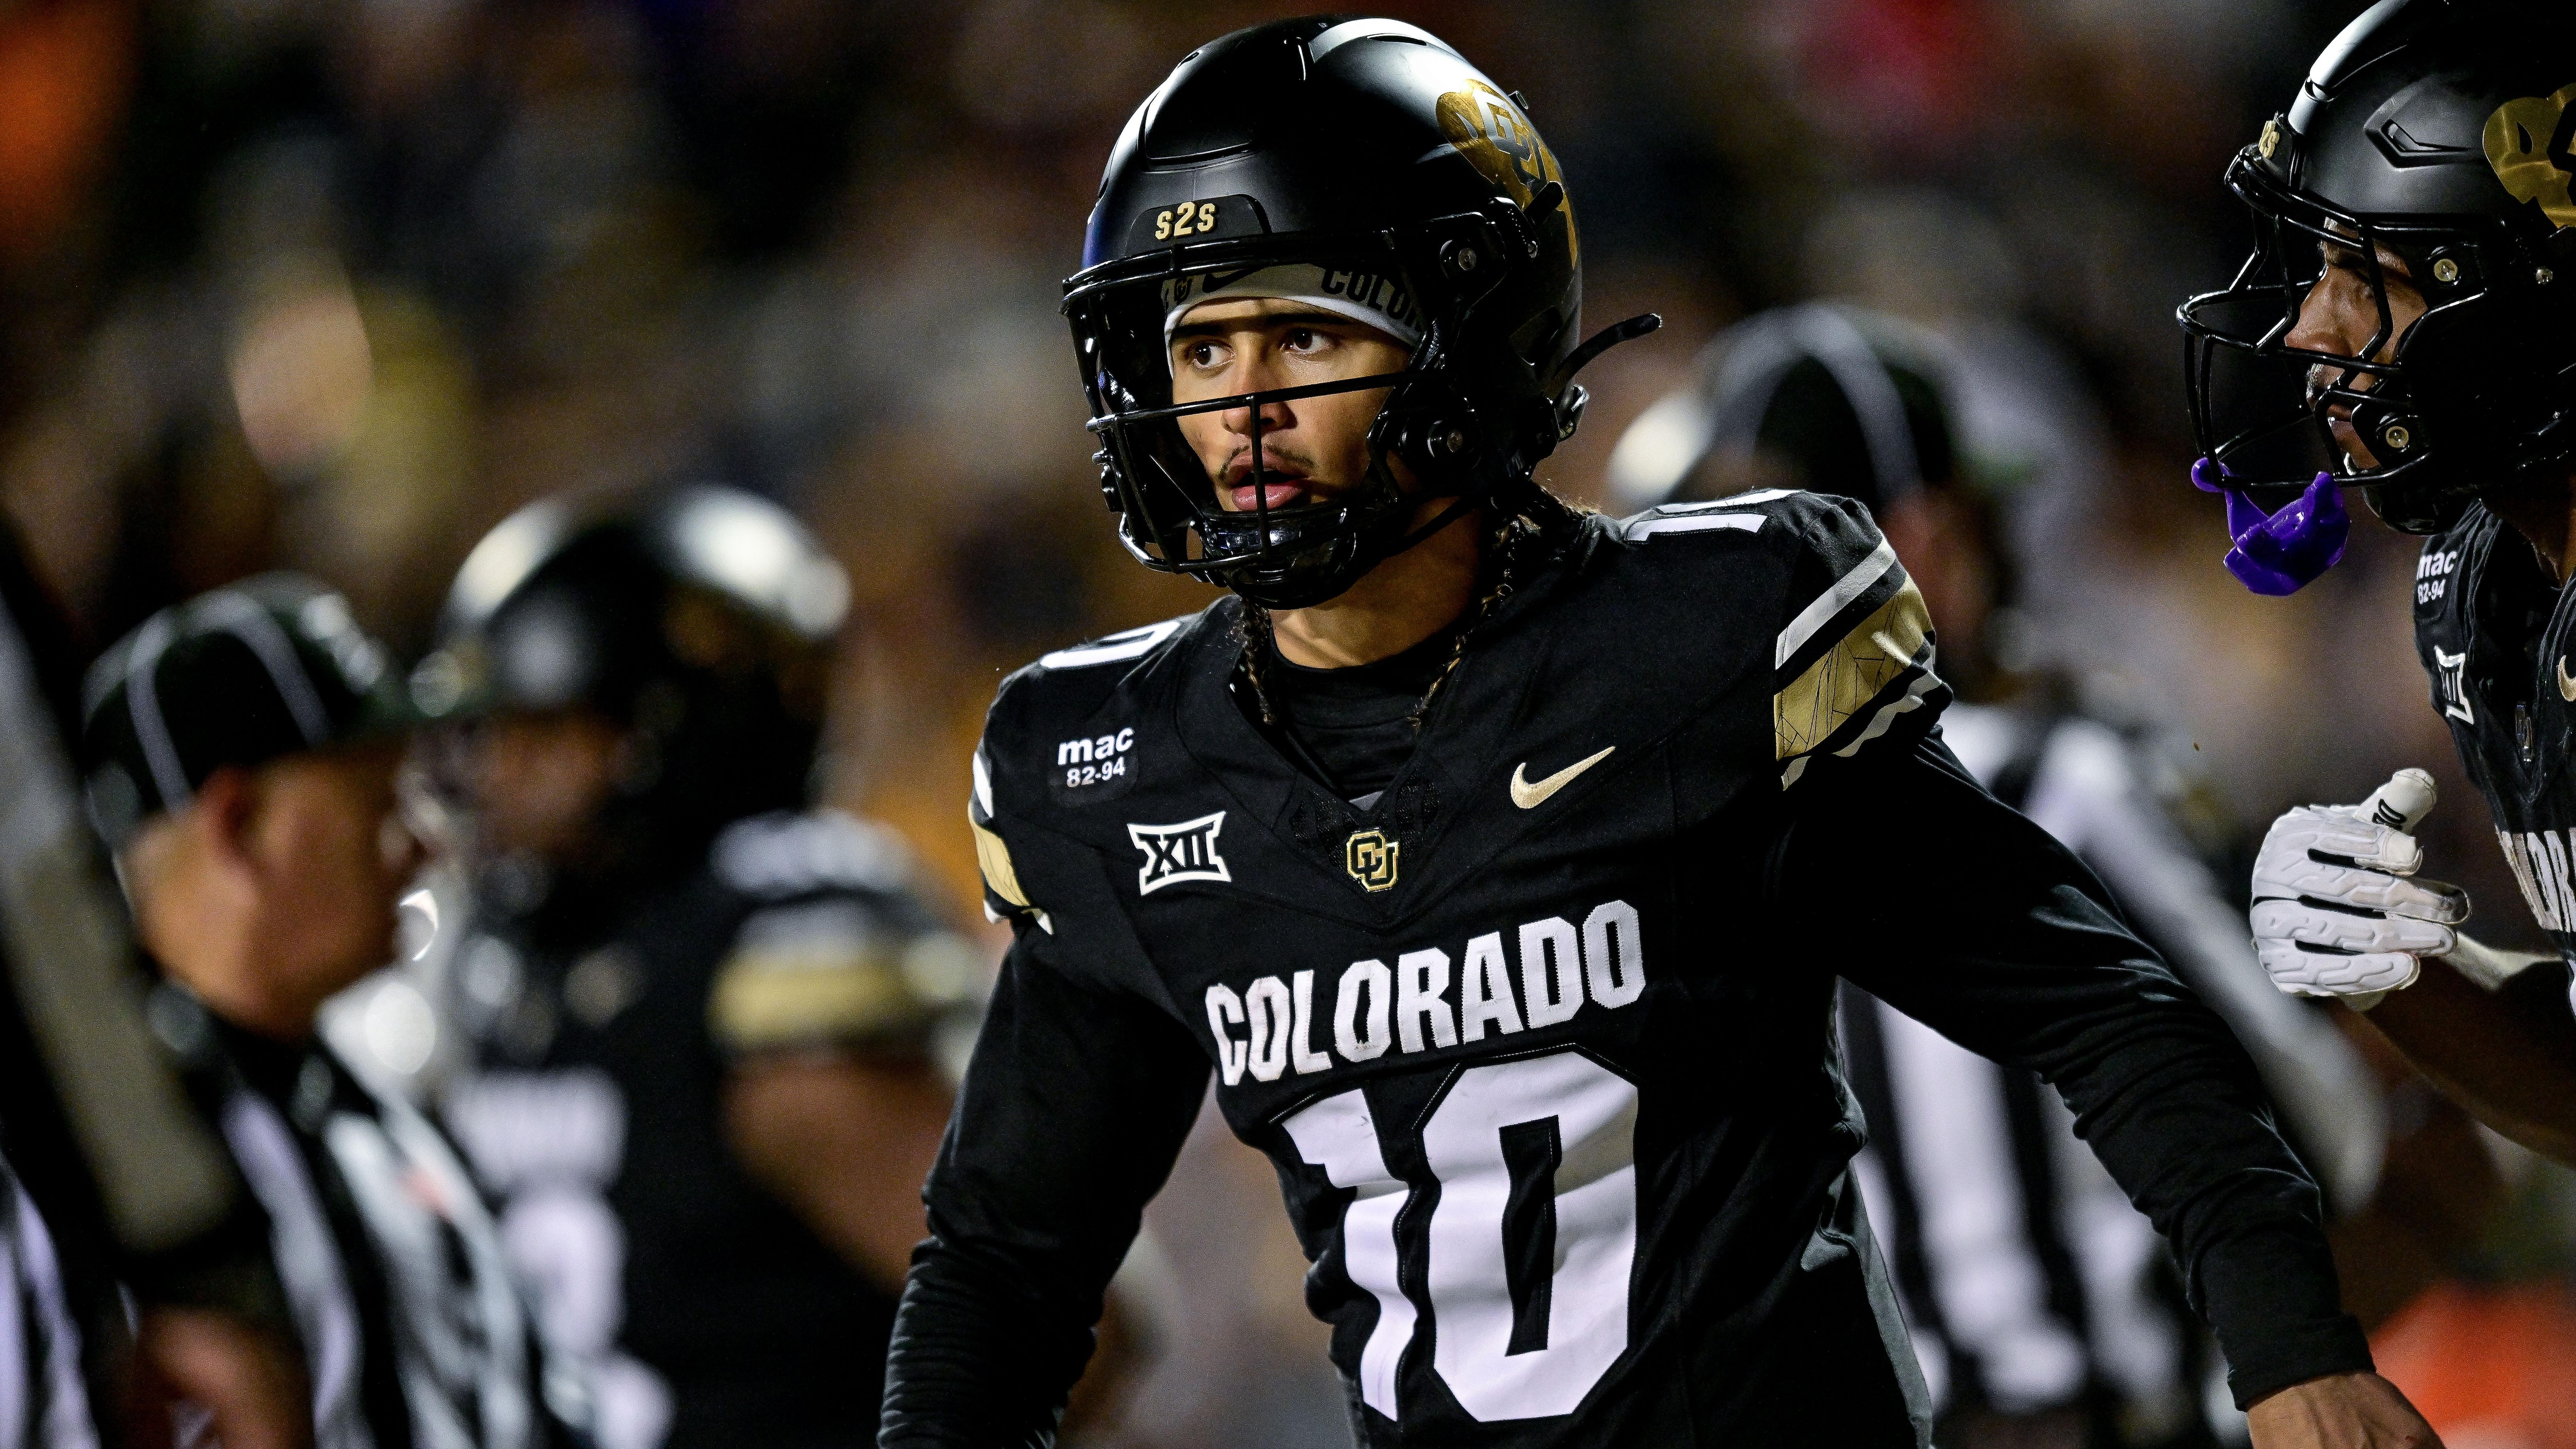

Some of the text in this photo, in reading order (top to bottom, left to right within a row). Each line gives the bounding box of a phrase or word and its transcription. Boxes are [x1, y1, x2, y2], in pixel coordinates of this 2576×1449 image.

[2417, 579, 2446, 604] 82-94
[1058, 727, 1133, 765] mac
[1066, 758, 1126, 789] 82-94
[1346, 830, 1399, 894] CU
[1205, 899, 1647, 1086] COLORADO
[1282, 1051, 1639, 1423] 10
